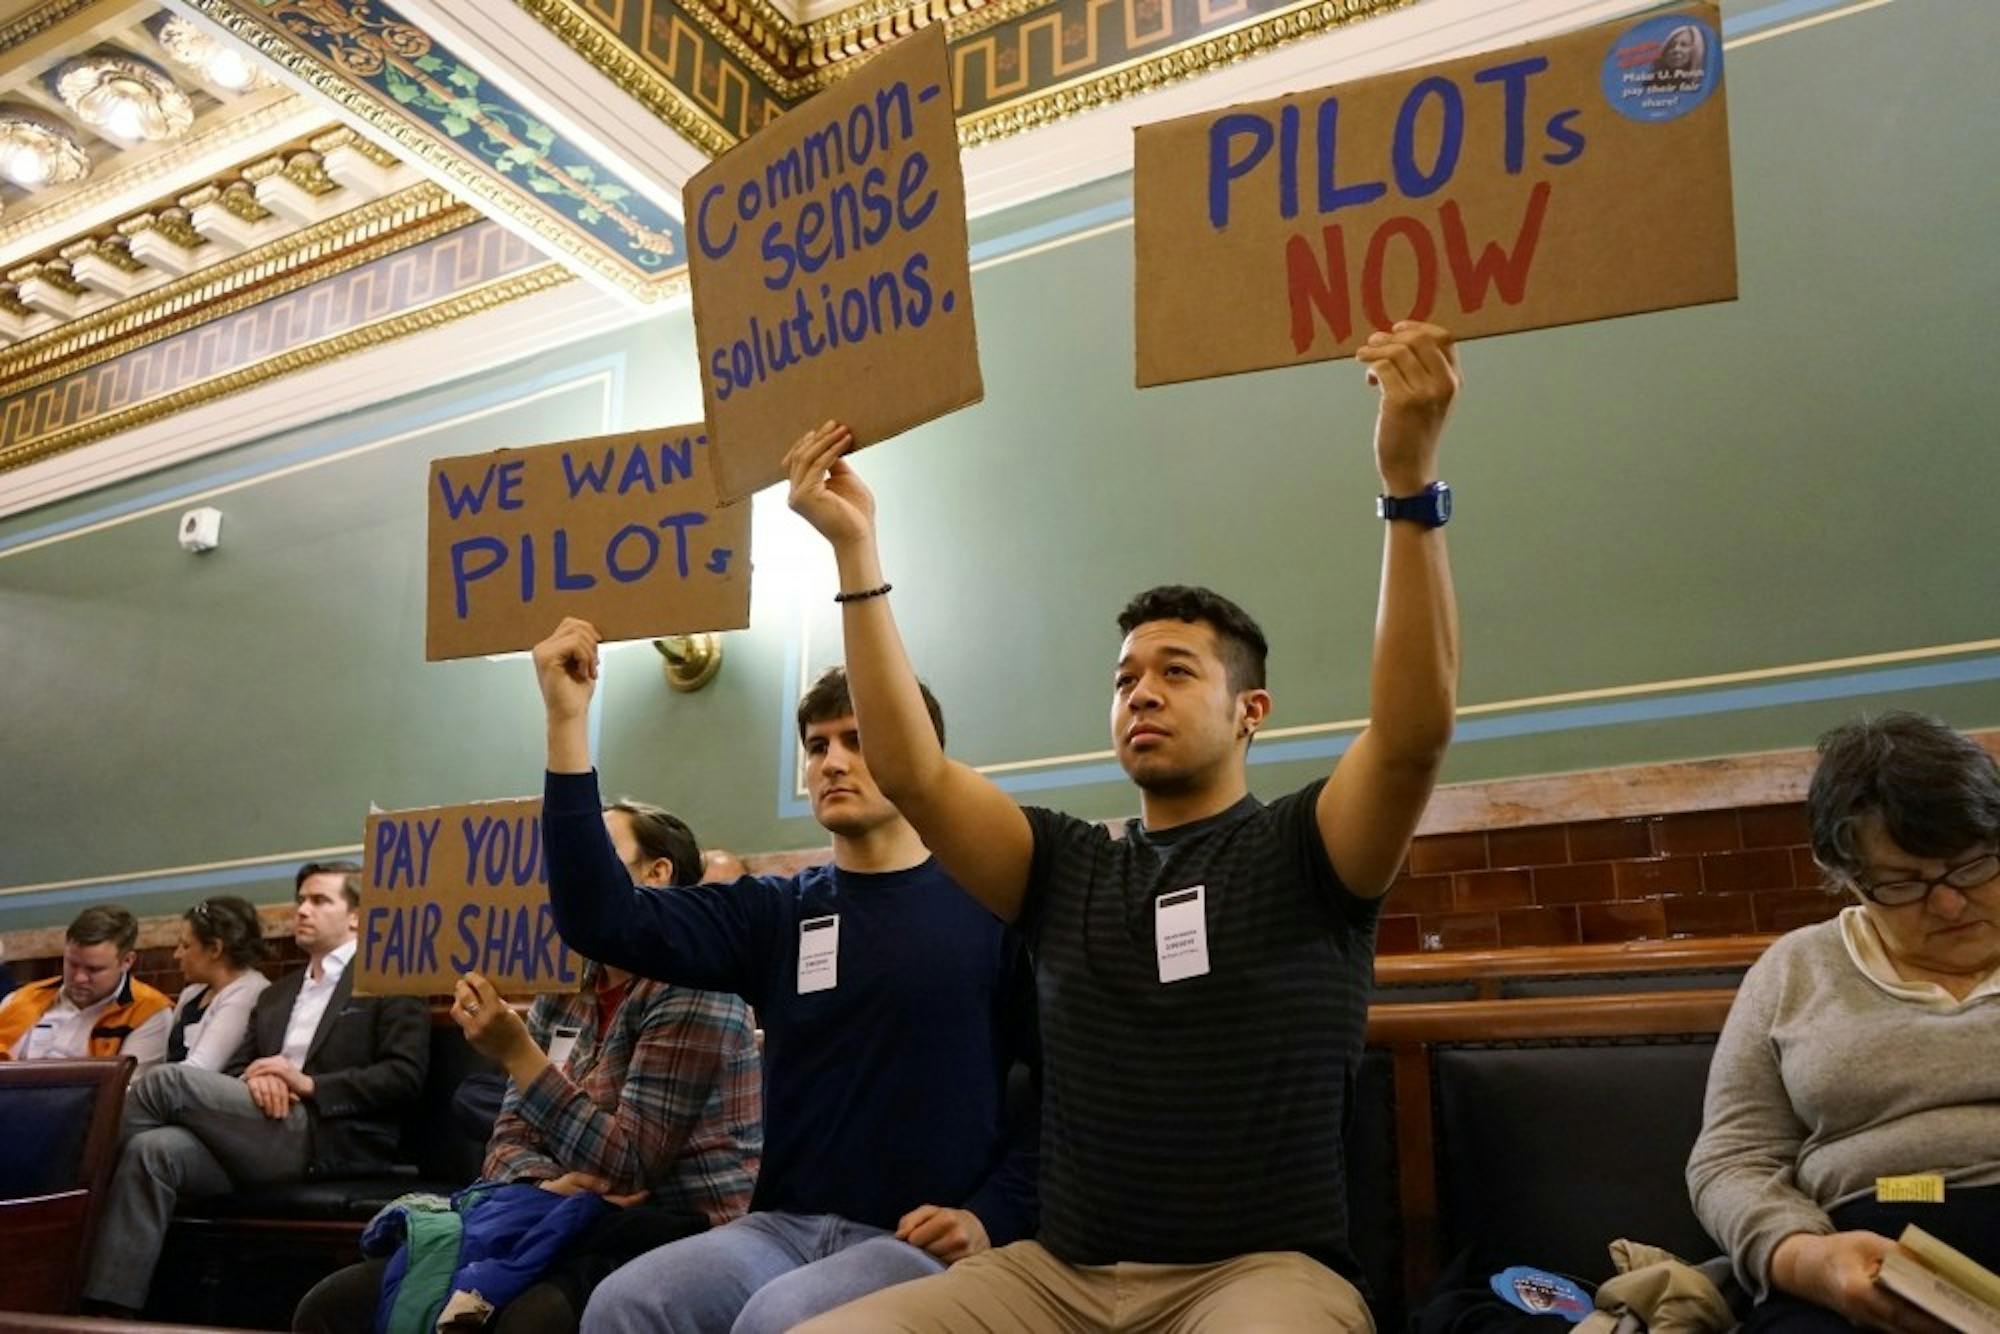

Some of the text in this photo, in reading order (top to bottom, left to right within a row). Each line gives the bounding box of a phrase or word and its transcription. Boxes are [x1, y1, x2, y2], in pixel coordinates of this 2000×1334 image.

[697, 80, 941, 260] Common-
[1208, 57, 1586, 233] PILOTs
[761, 151, 939, 291] sense
[1285, 181, 1551, 355] NOW
[711, 252, 954, 400] solutions.
[439, 435, 707, 520] WE WAN
[452, 511, 732, 620] PILOTs
[373, 817, 441, 890] PAY
[365, 902, 442, 979] FAIR
